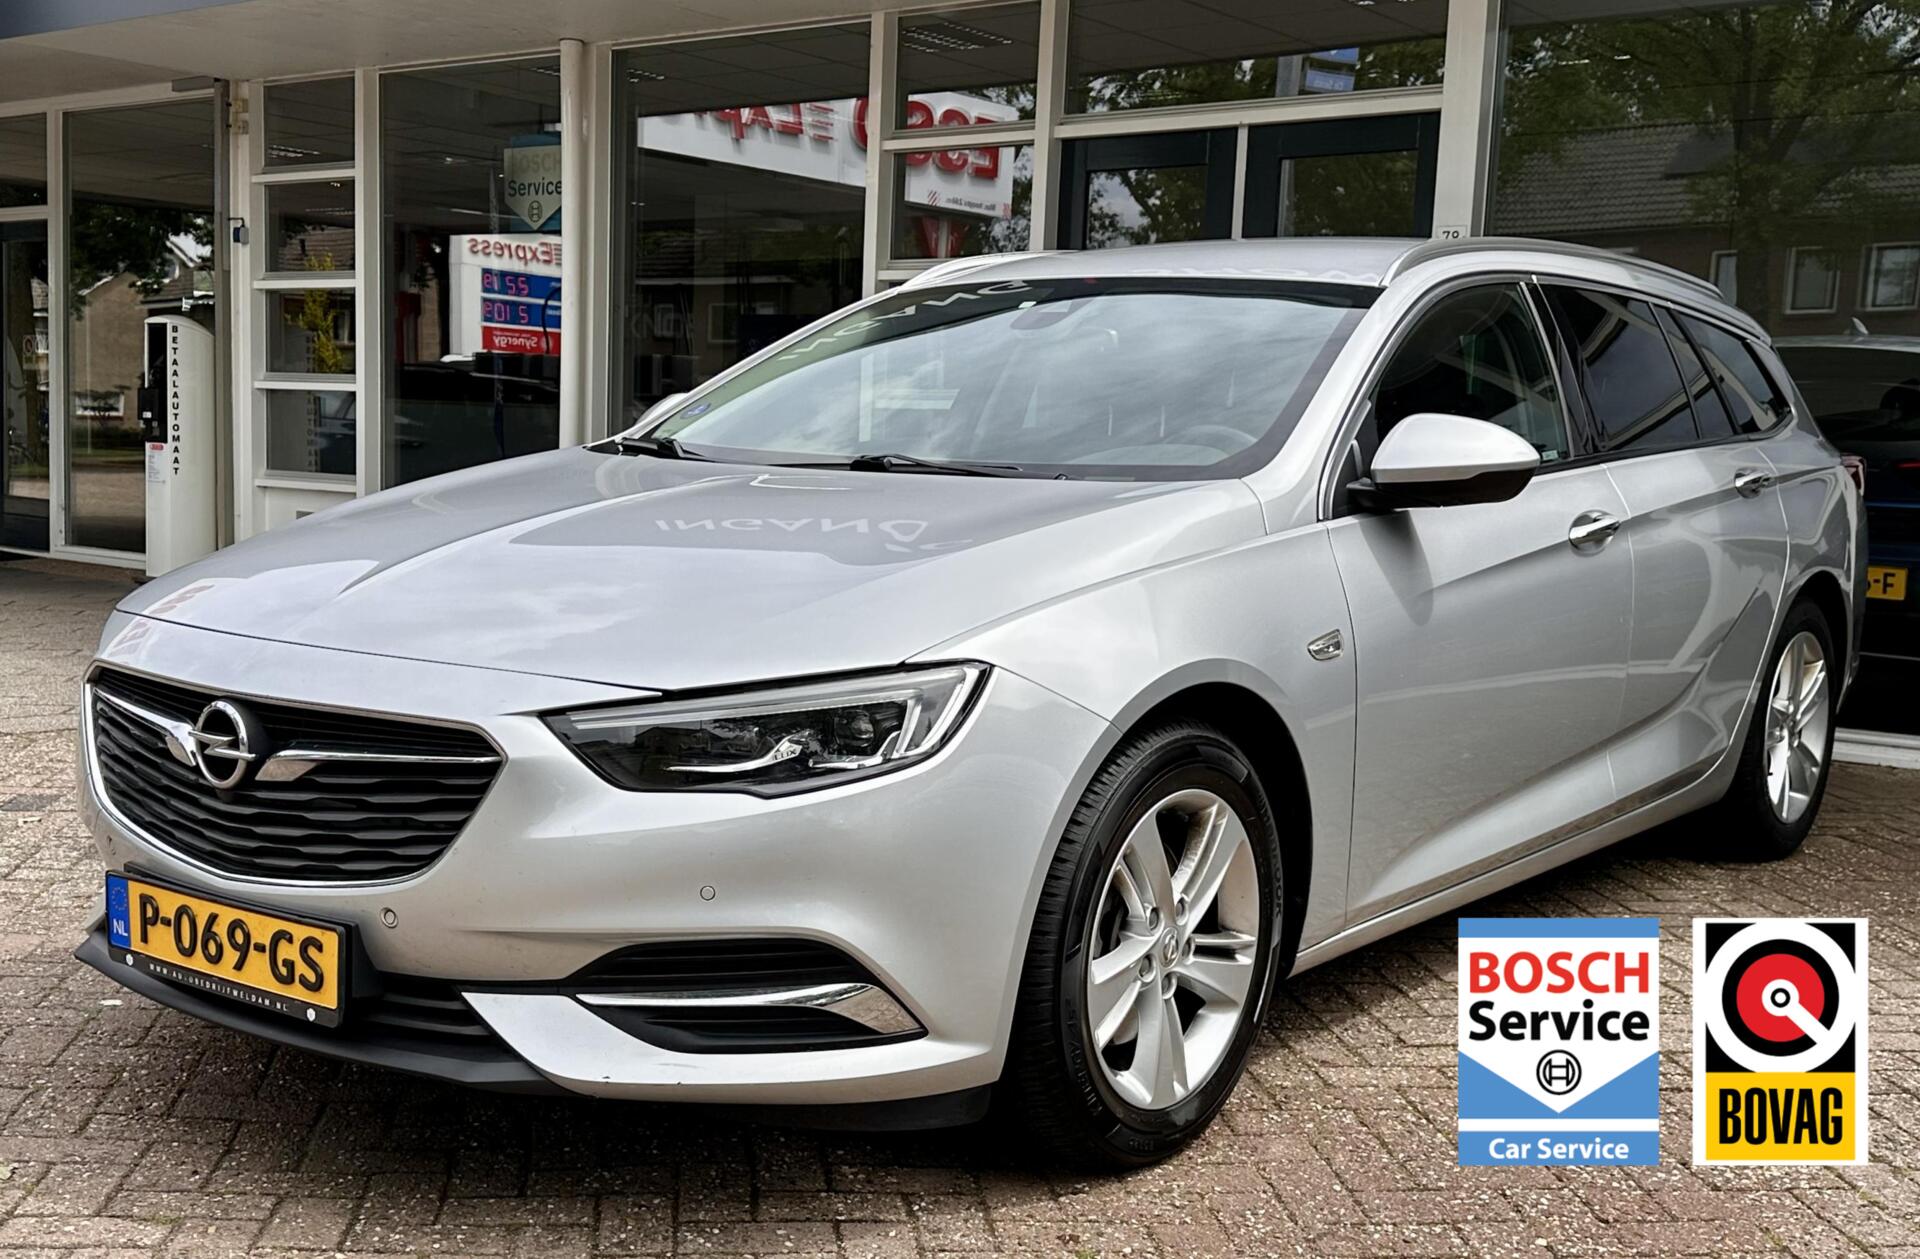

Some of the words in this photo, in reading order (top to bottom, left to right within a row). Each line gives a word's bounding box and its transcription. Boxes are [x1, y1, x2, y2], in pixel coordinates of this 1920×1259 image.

[507, 177, 562, 197] Service
[170, 325, 182, 476] BETAALAUTOMAAT
[113, 918, 129, 937] NL
[138, 892, 325, 993] P-069-GS
